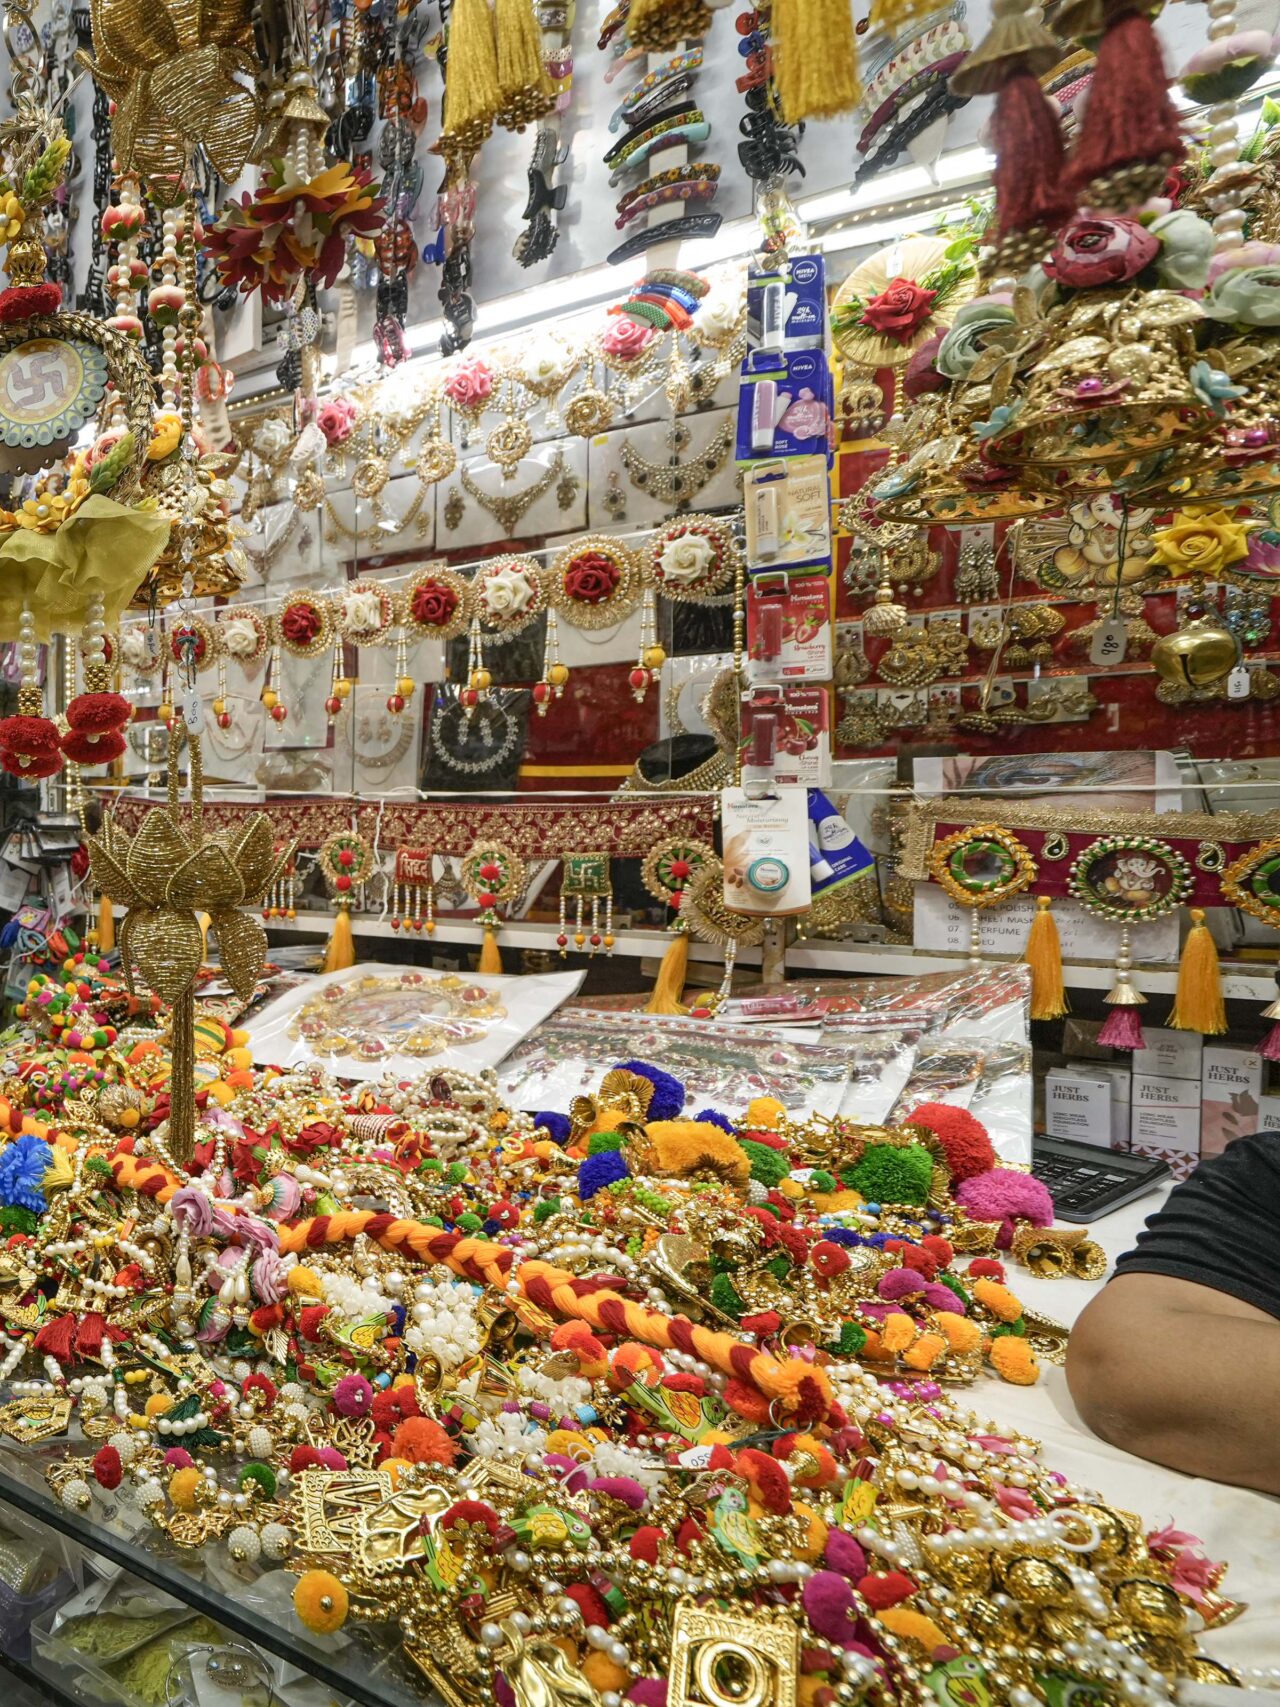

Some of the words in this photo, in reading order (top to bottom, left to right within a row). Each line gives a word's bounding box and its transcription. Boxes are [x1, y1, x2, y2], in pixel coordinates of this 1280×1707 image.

[796, 267, 815, 275] NIVEA
[792, 363, 813, 372] NIVEA
[796, 490, 821, 502] SOFT
[1208, 1064, 1239, 1075] JUST
[1208, 1072, 1251, 1084] HERBS
[1052, 1085, 1081, 1094] JUST
[1140, 1085, 1170, 1094] JUST
[1053, 1092, 1089, 1102] HERBS
[1140, 1092, 1179, 1102] HERBS
